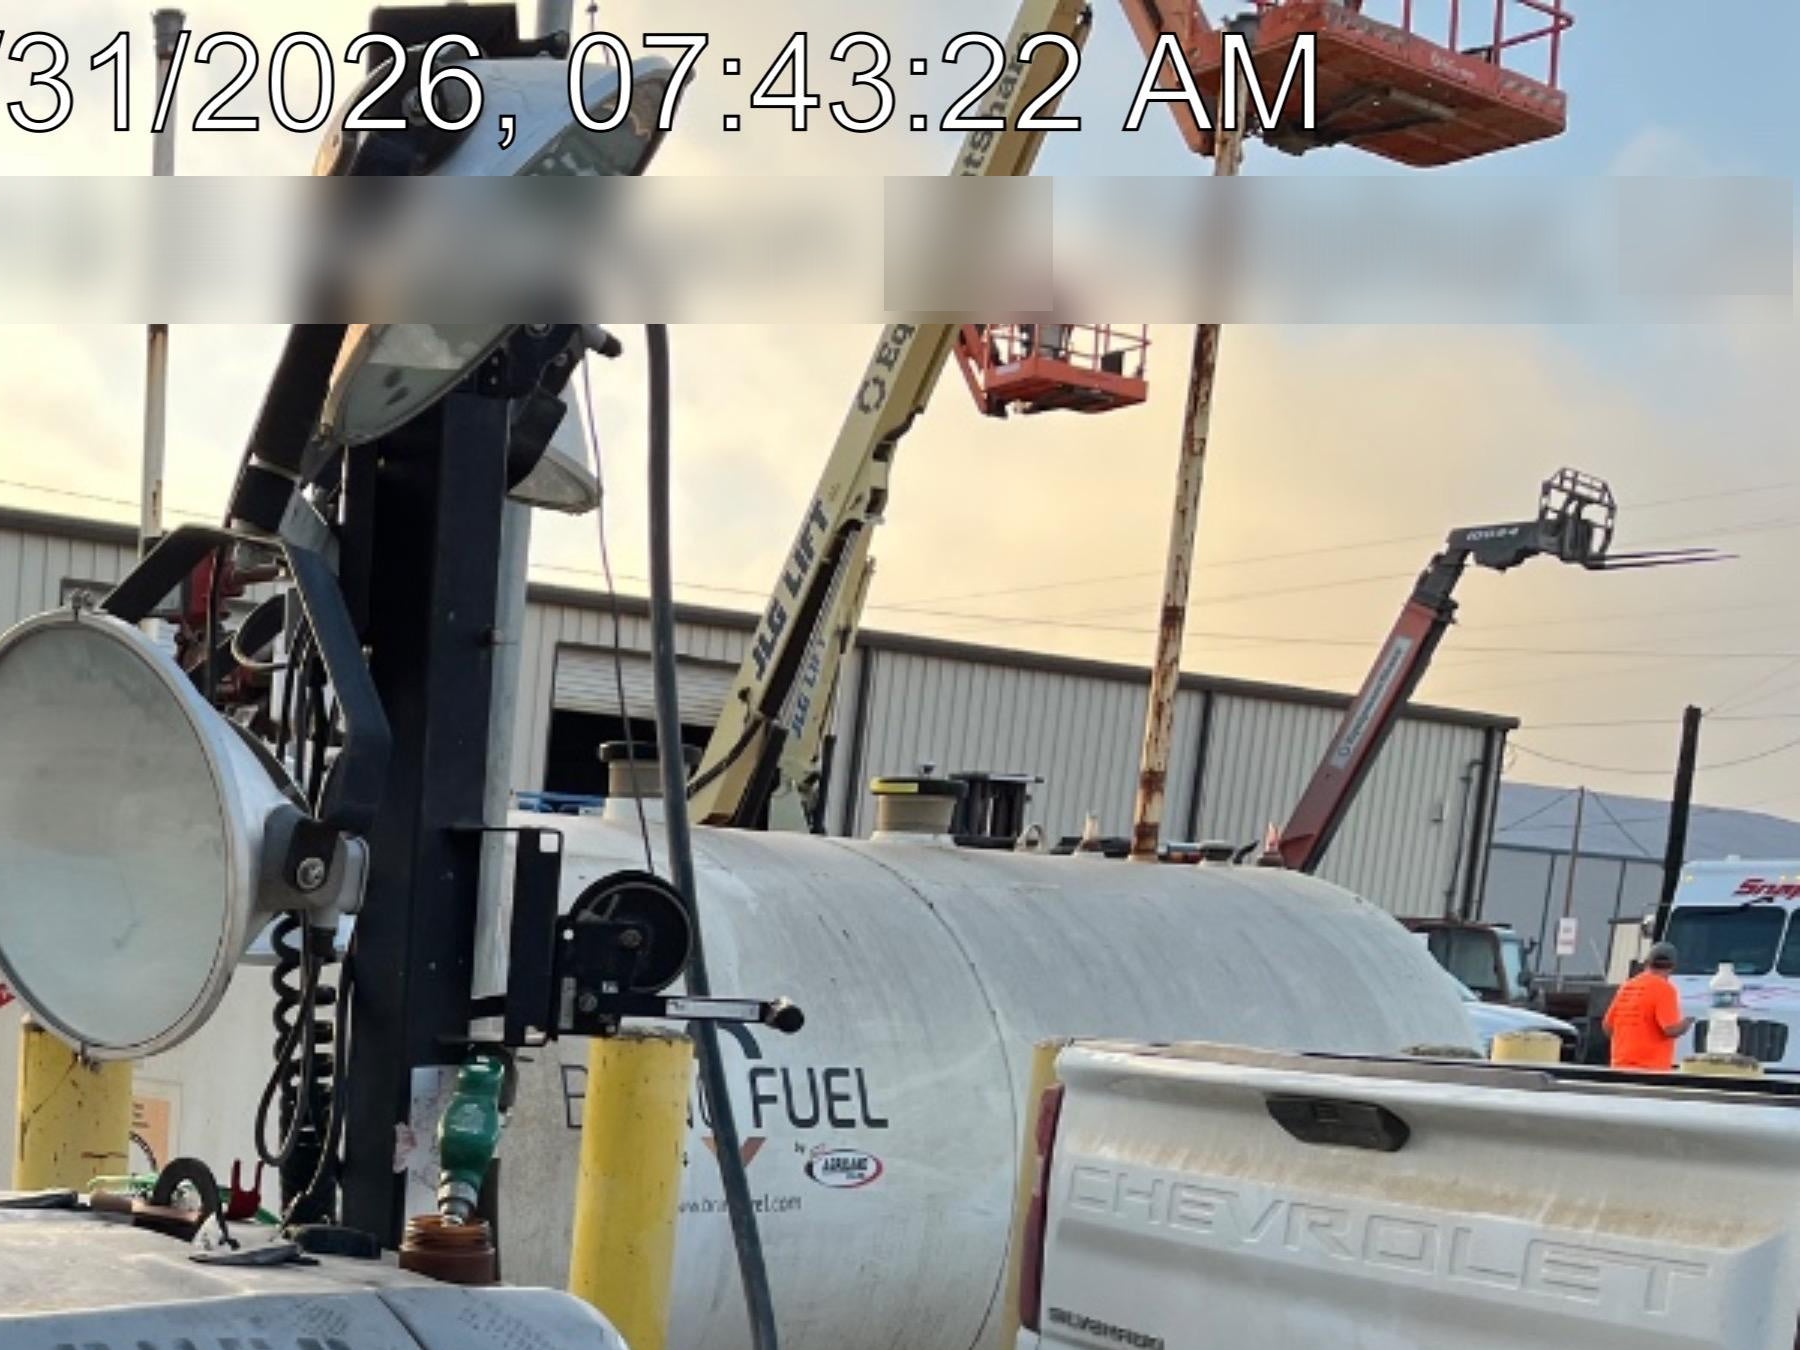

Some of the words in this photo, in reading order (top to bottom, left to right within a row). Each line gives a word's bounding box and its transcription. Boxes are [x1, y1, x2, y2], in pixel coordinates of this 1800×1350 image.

[752, 597, 788, 681] JLG
[783, 499, 828, 599] LIFT
[792, 692, 810, 740] JLG
[749, 1066, 889, 1130] FUEL
[1066, 1166, 1709, 1316] CHEVROLET
